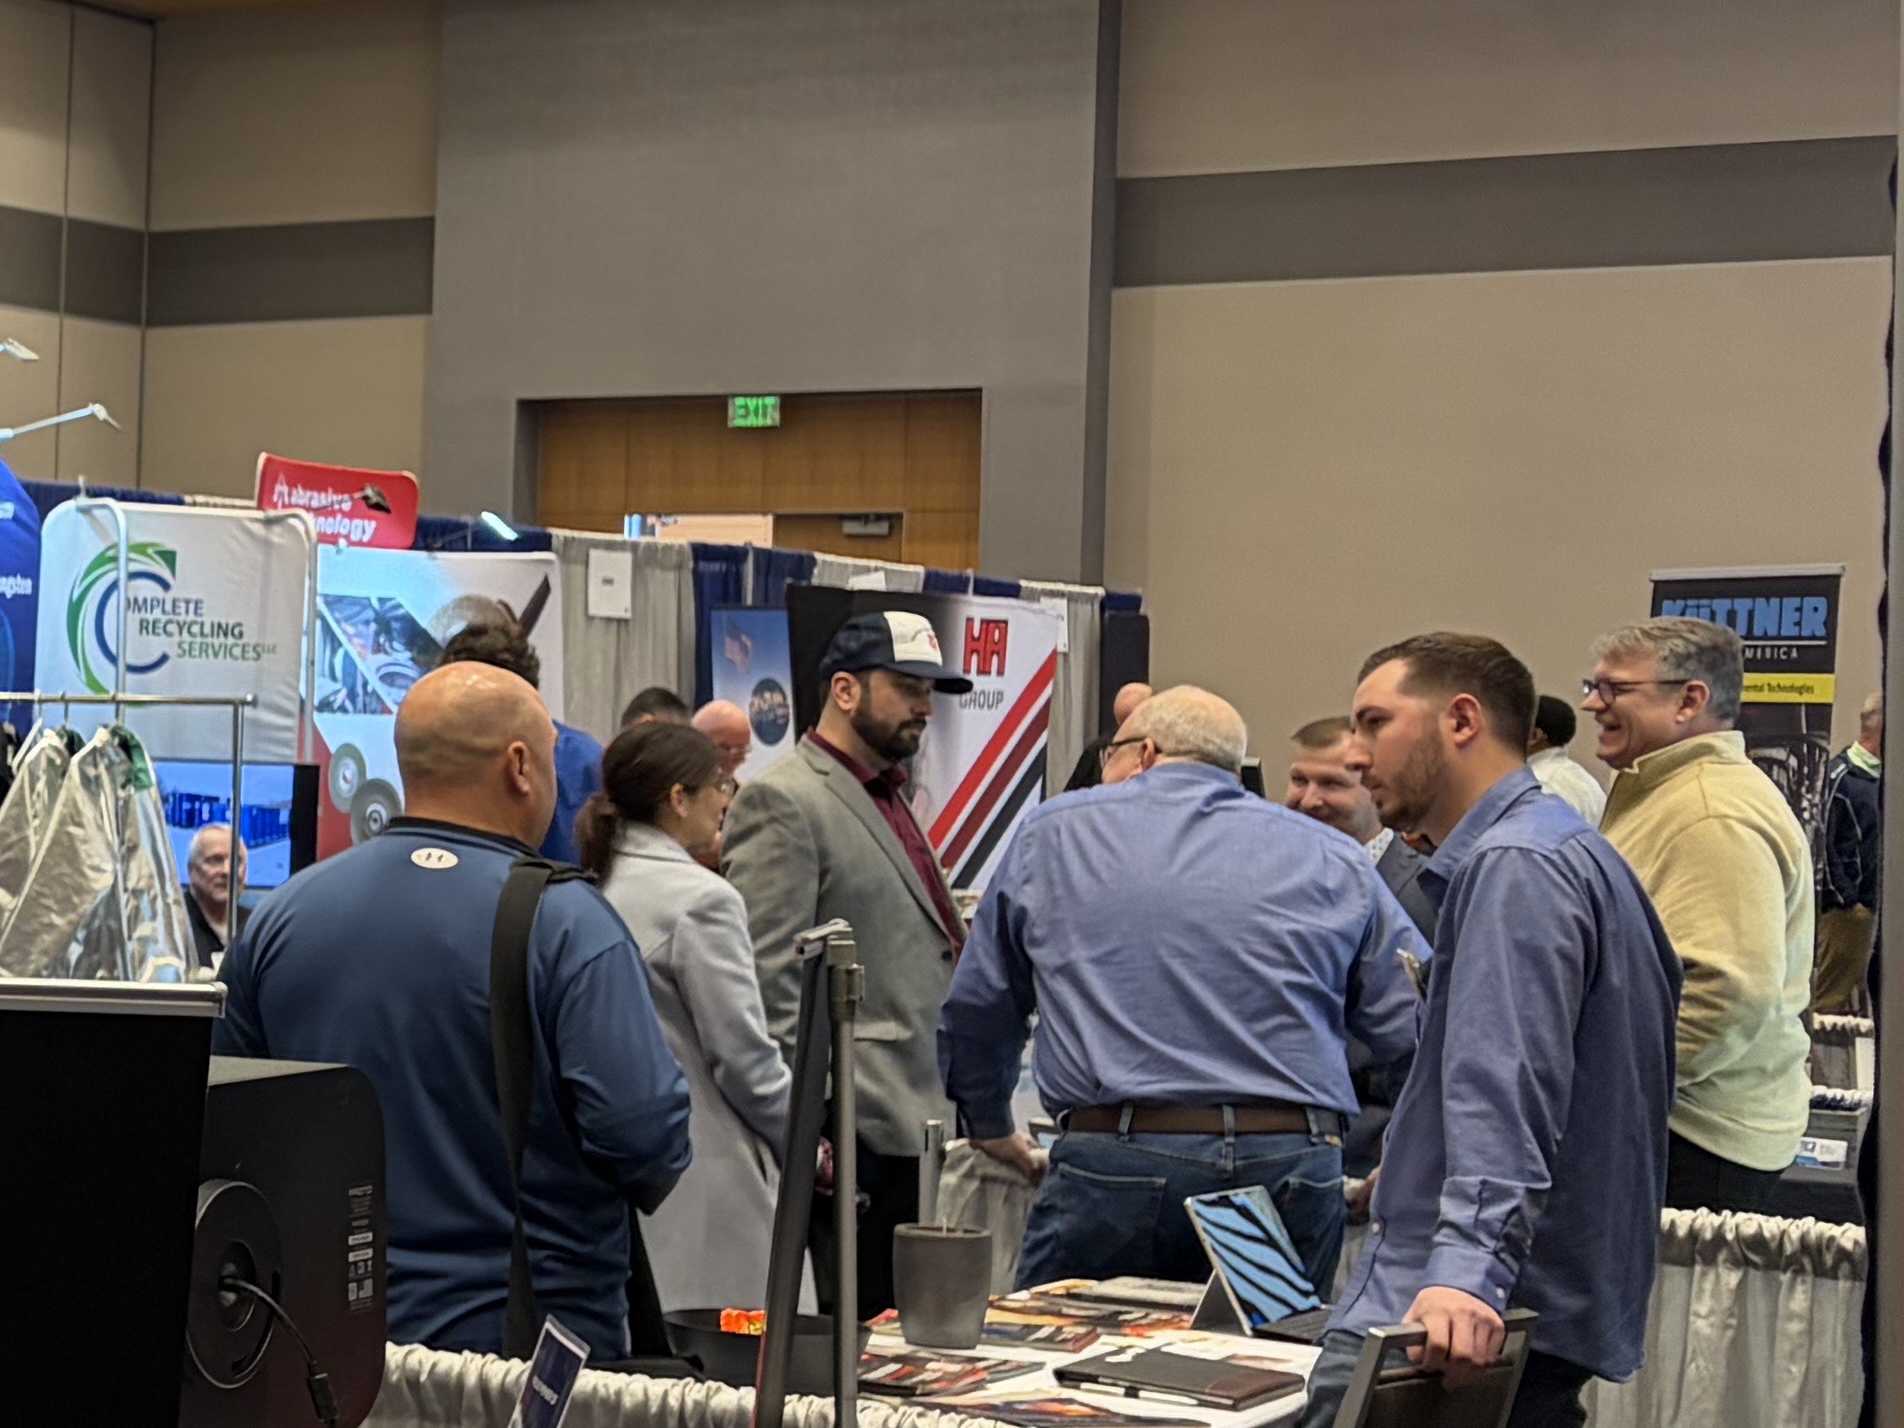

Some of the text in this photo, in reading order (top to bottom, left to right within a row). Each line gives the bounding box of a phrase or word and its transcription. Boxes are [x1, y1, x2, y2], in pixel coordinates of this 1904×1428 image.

[735, 396, 775, 428] EXIT
[138, 617, 245, 641] RECYCLING
[176, 639, 261, 662] SERVICES
